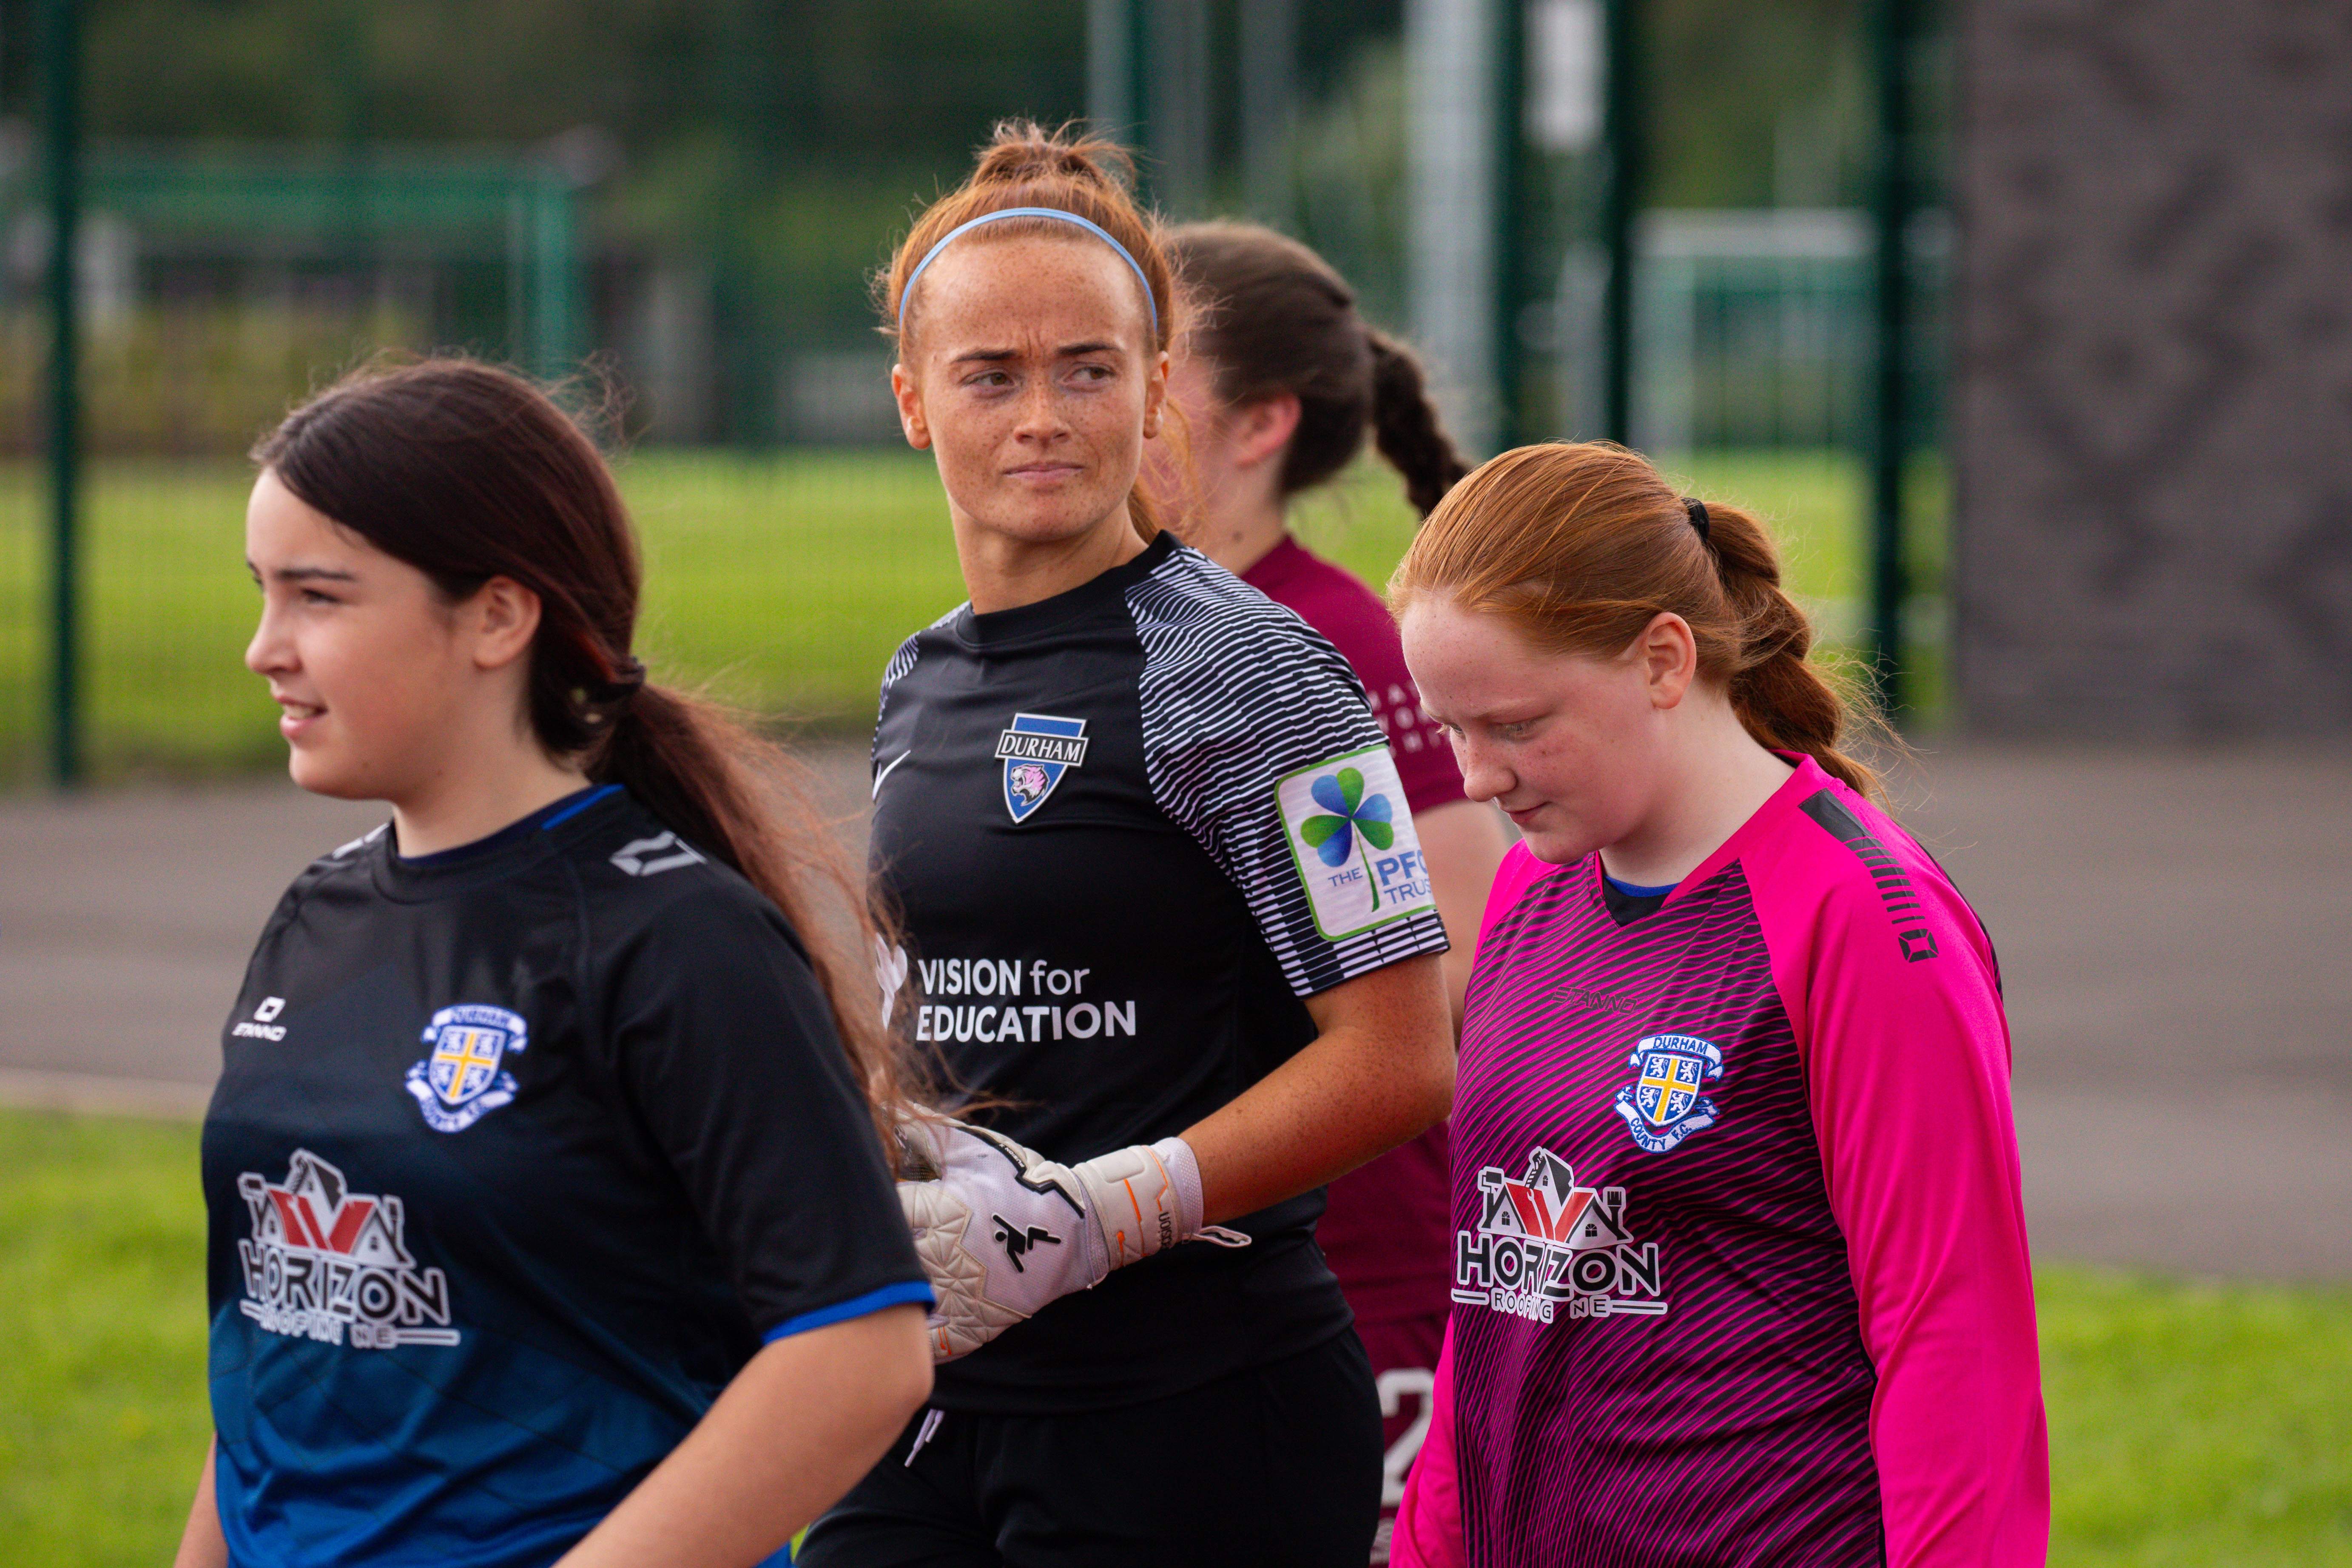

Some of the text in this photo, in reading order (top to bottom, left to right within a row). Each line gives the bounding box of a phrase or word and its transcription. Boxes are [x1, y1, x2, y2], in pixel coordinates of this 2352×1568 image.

[1001, 735, 1081, 762] DURHAM
[1328, 867, 1363, 887] THE
[918, 958, 1090, 996] VISION for
[1552, 986, 1638, 1015] STANNO
[916, 1000, 1136, 1043] EDUCATION
[1652, 1036, 1708, 1055] DURHAM
[1630, 1118, 1692, 1150] COUNTY F.C.
[238, 1238, 452, 1326] HORIZON
[1457, 1230, 1660, 1301] HORIZON
[1491, 1288, 1611, 1324] ROOFING NE
